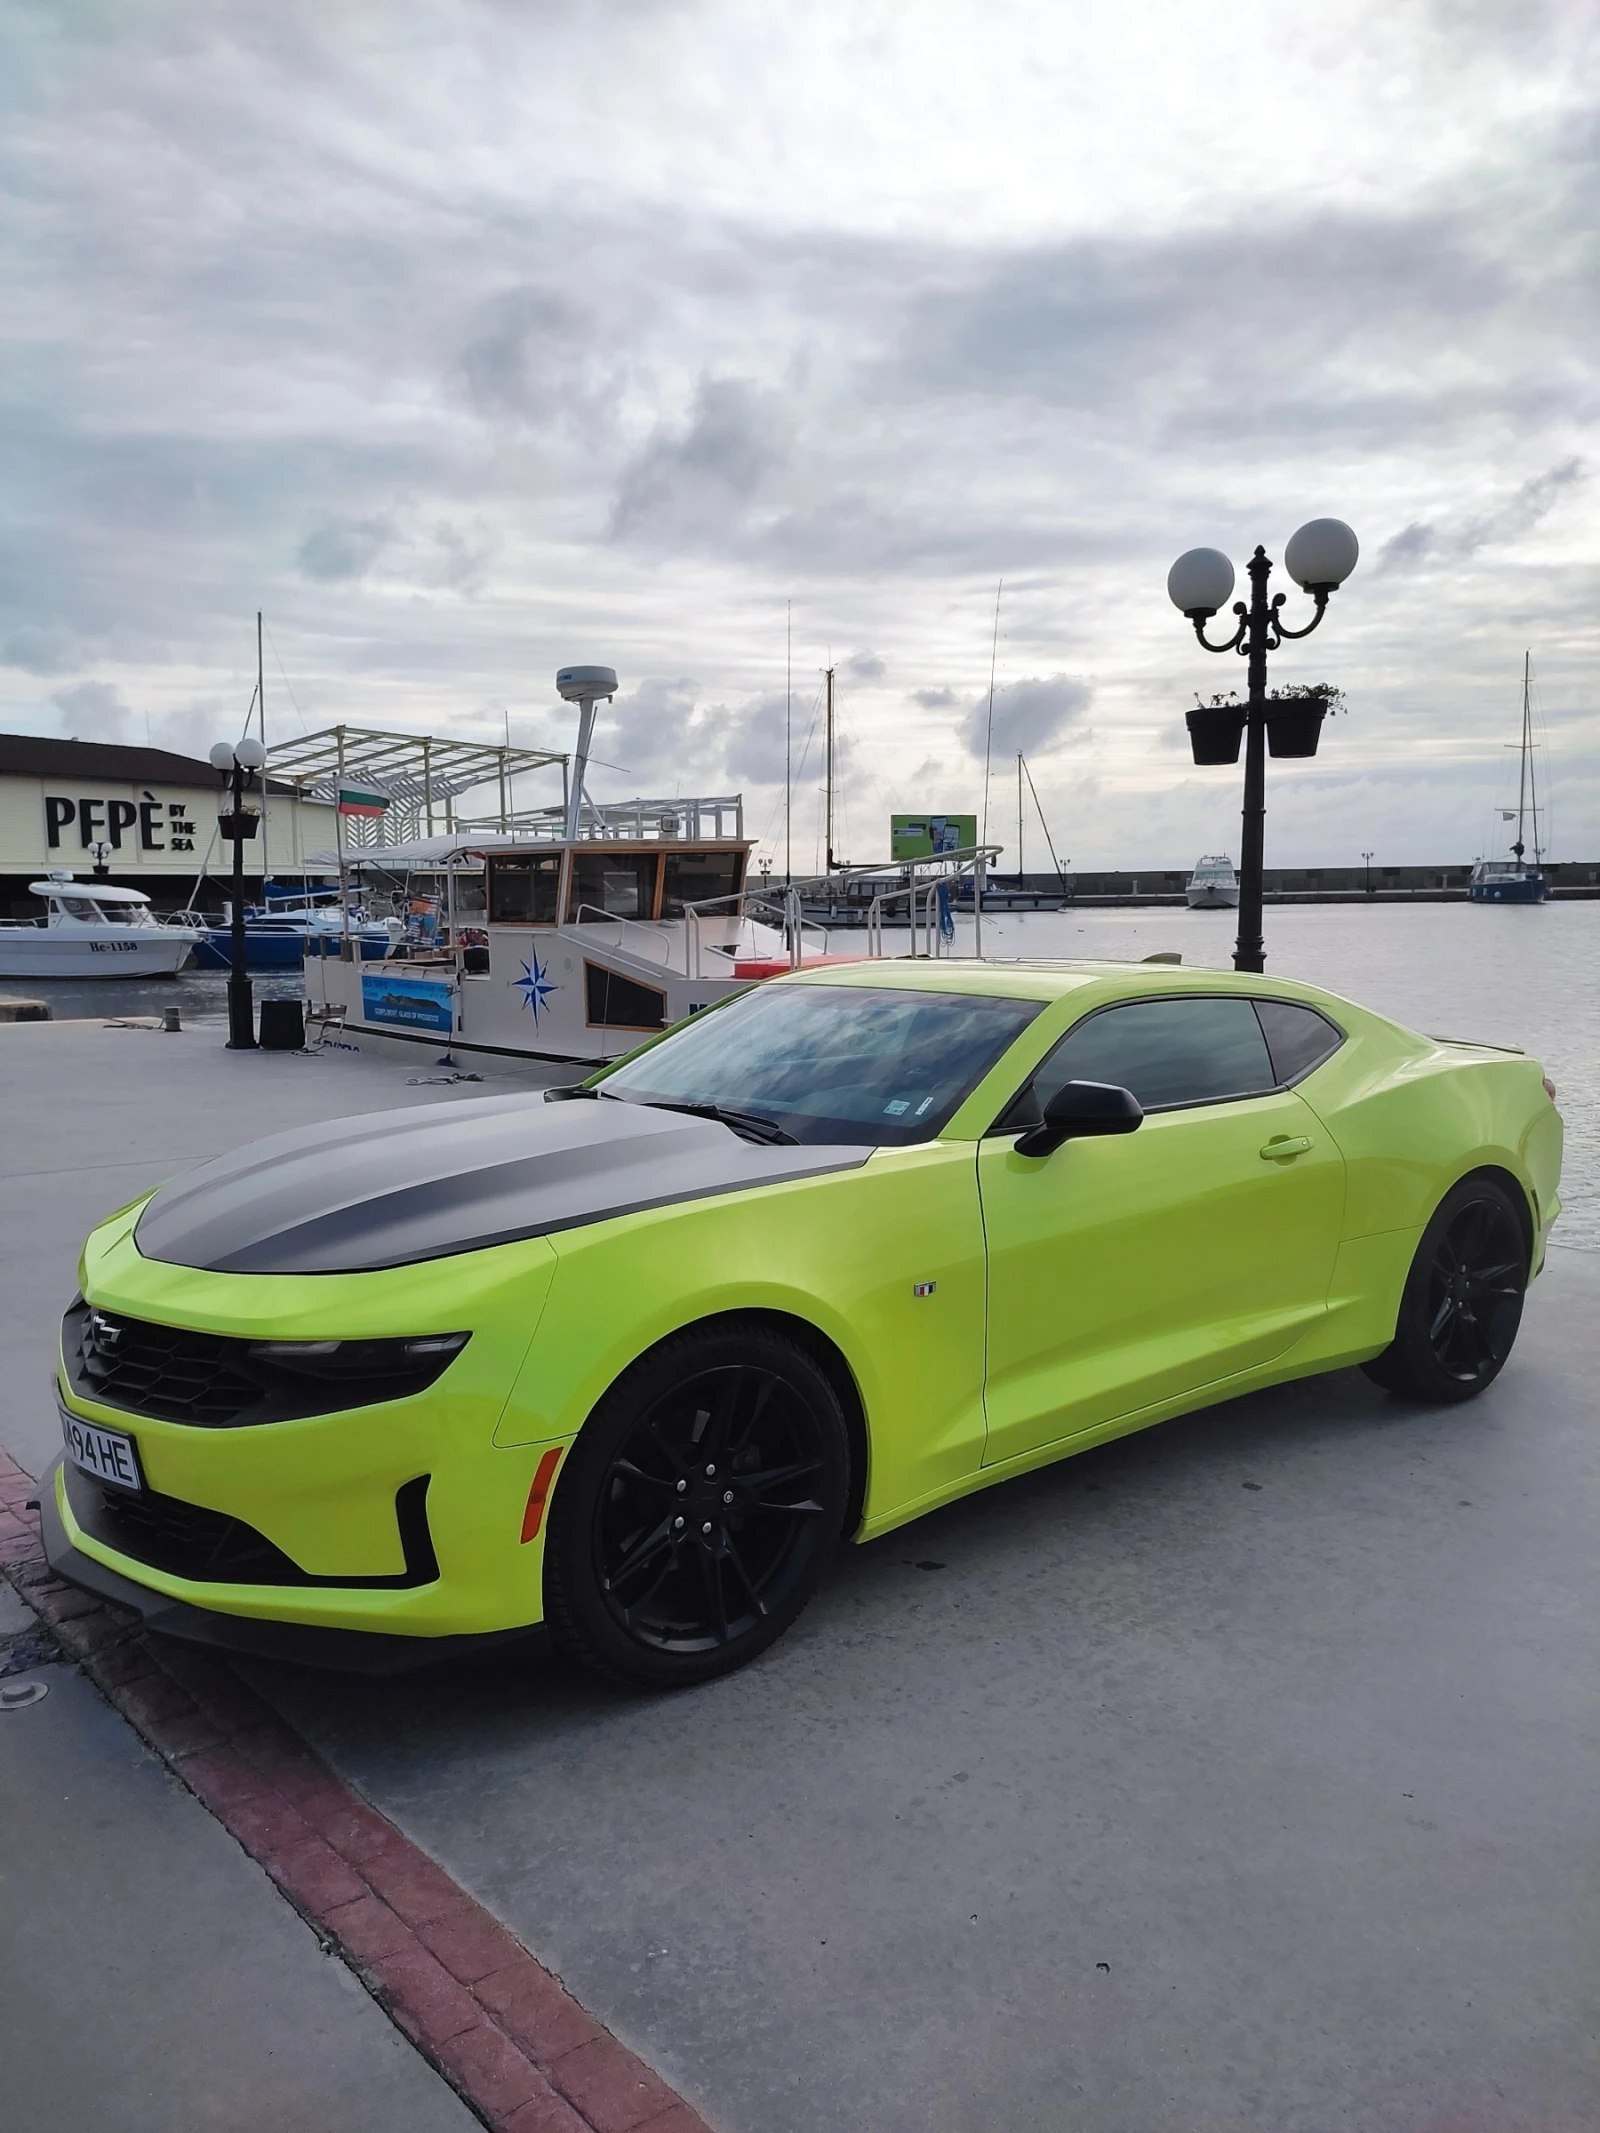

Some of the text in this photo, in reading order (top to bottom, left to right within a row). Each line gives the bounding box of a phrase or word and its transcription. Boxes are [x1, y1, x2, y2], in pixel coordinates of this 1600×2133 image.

[169, 804, 187, 817] BY
[45, 790, 165, 850] PEPÈ
[170, 821, 196, 834] THE
[171, 838, 195, 851] SEA
